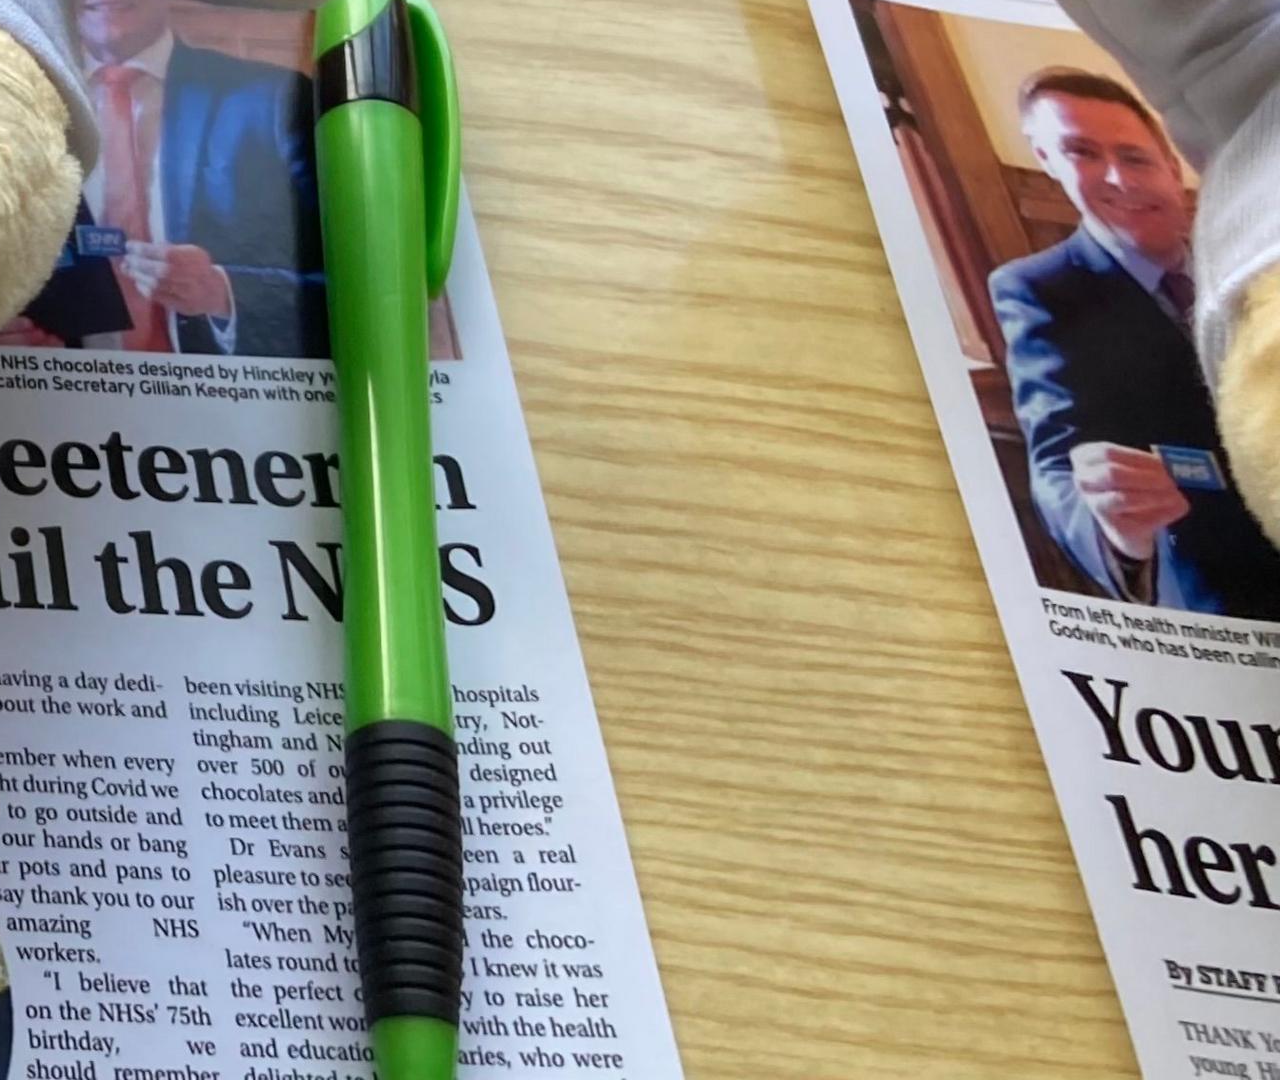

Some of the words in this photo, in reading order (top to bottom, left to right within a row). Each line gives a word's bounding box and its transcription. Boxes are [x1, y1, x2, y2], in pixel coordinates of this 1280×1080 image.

[0, 355, 39, 371] NHS
[43, 357, 134, 375] chocolates
[138, 361, 215, 381] designed
[218, 364, 238, 383] by
[242, 366, 315, 386] Hinckley
[52, 376, 135, 398] Secretary
[139, 380, 192, 396] Gillian
[195, 382, 260, 402] Keegan
[263, 386, 300, 401] with
[304, 390, 335, 402] one
[94, 529, 253, 620] the
[269, 539, 497, 629] NS
[1041, 598, 1085, 620] From
[1086, 606, 1122, 630] left,
[1121, 612, 1178, 635] health
[1180, 624, 1250, 645] minister
[1049, 620, 1117, 649] Godwin,
[1117, 634, 1155, 653] who
[41, 695, 71, 714] the
[77, 698, 126, 717] work
[131, 700, 167, 718] and
[1104, 794, 1280, 910] her
[1164, 959, 1192, 986] By
[1196, 965, 1267, 992] STAFF
[1178, 1020, 1256, 1050] THANK
